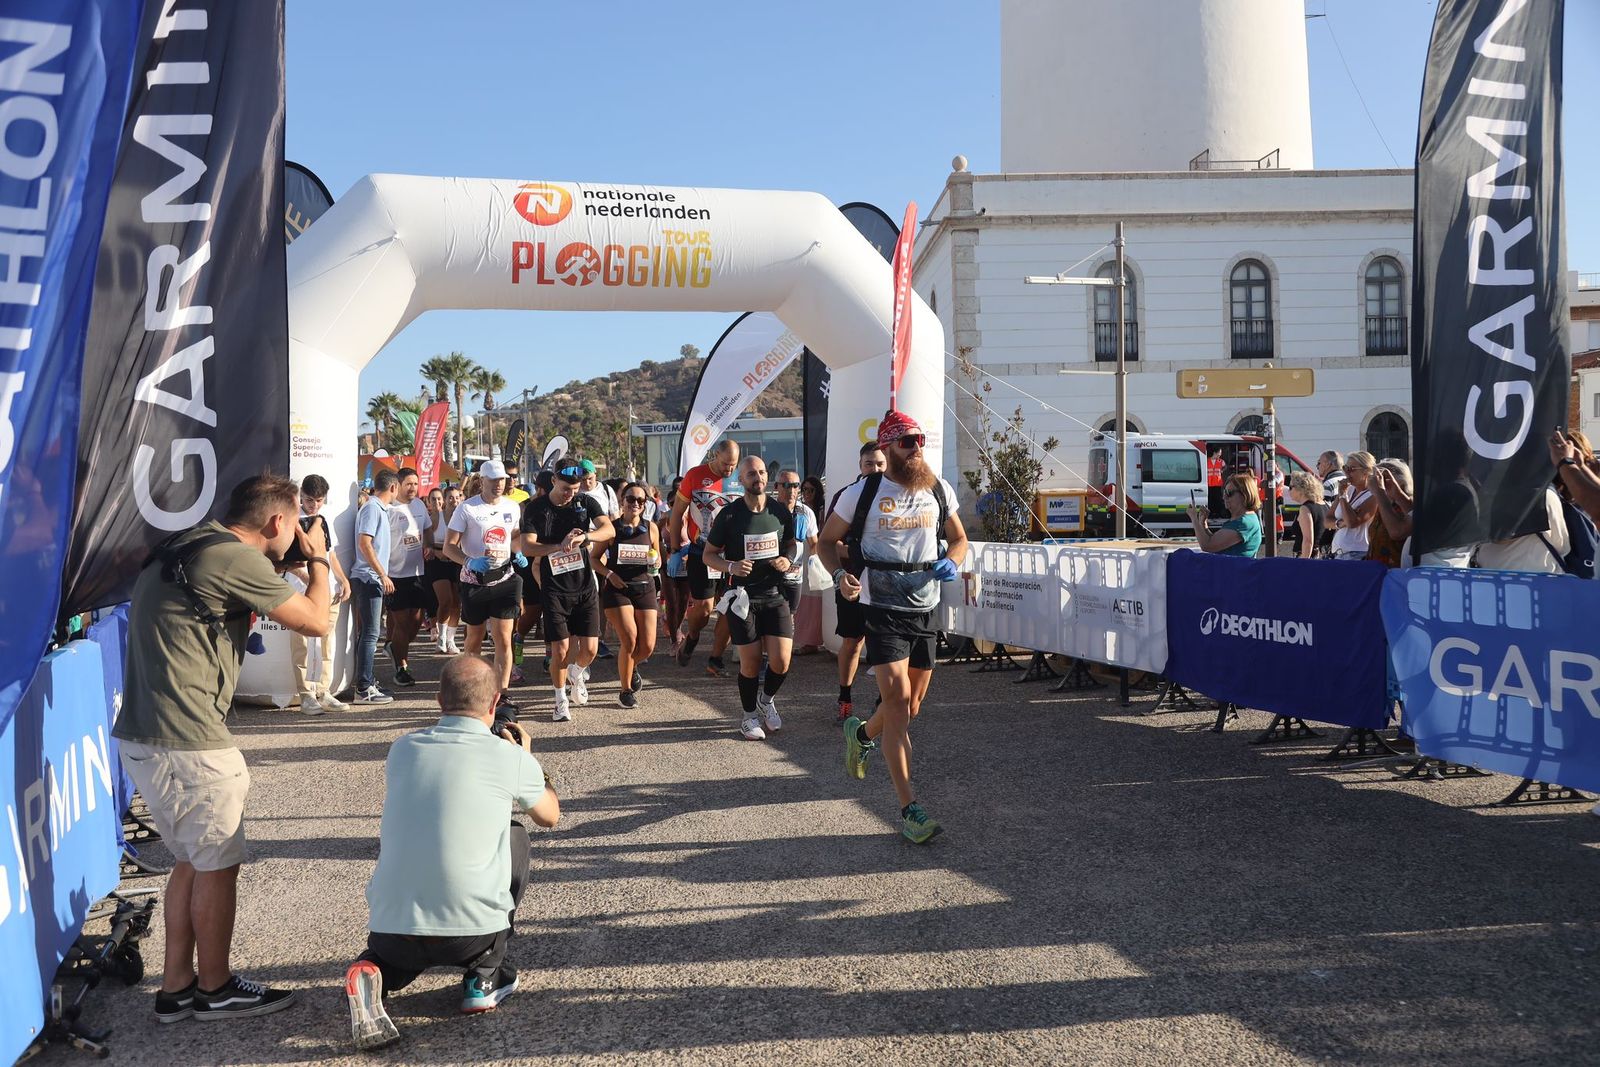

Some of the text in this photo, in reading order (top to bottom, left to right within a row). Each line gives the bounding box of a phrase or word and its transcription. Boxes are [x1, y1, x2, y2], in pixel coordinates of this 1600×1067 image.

[583, 190, 676, 202] nationale
[585, 202, 711, 220] nederlanden
[663, 230, 711, 245] TOUR
[511, 241, 712, 288] PLOGGING
[705, 395, 729, 423] nationale
[710, 392, 742, 427] nederlanden
[292, 436, 321, 444] Consejo
[292, 443, 323, 451] Superior
[747, 541, 776, 550] 24380
[553, 554, 579, 566] 24937
[994, 579, 1001, 587] de
[1002, 580, 1043, 592] Recuperación,
[1113, 598, 1144, 616] AETIB
[1221, 613, 1313, 646] DECATHLON
